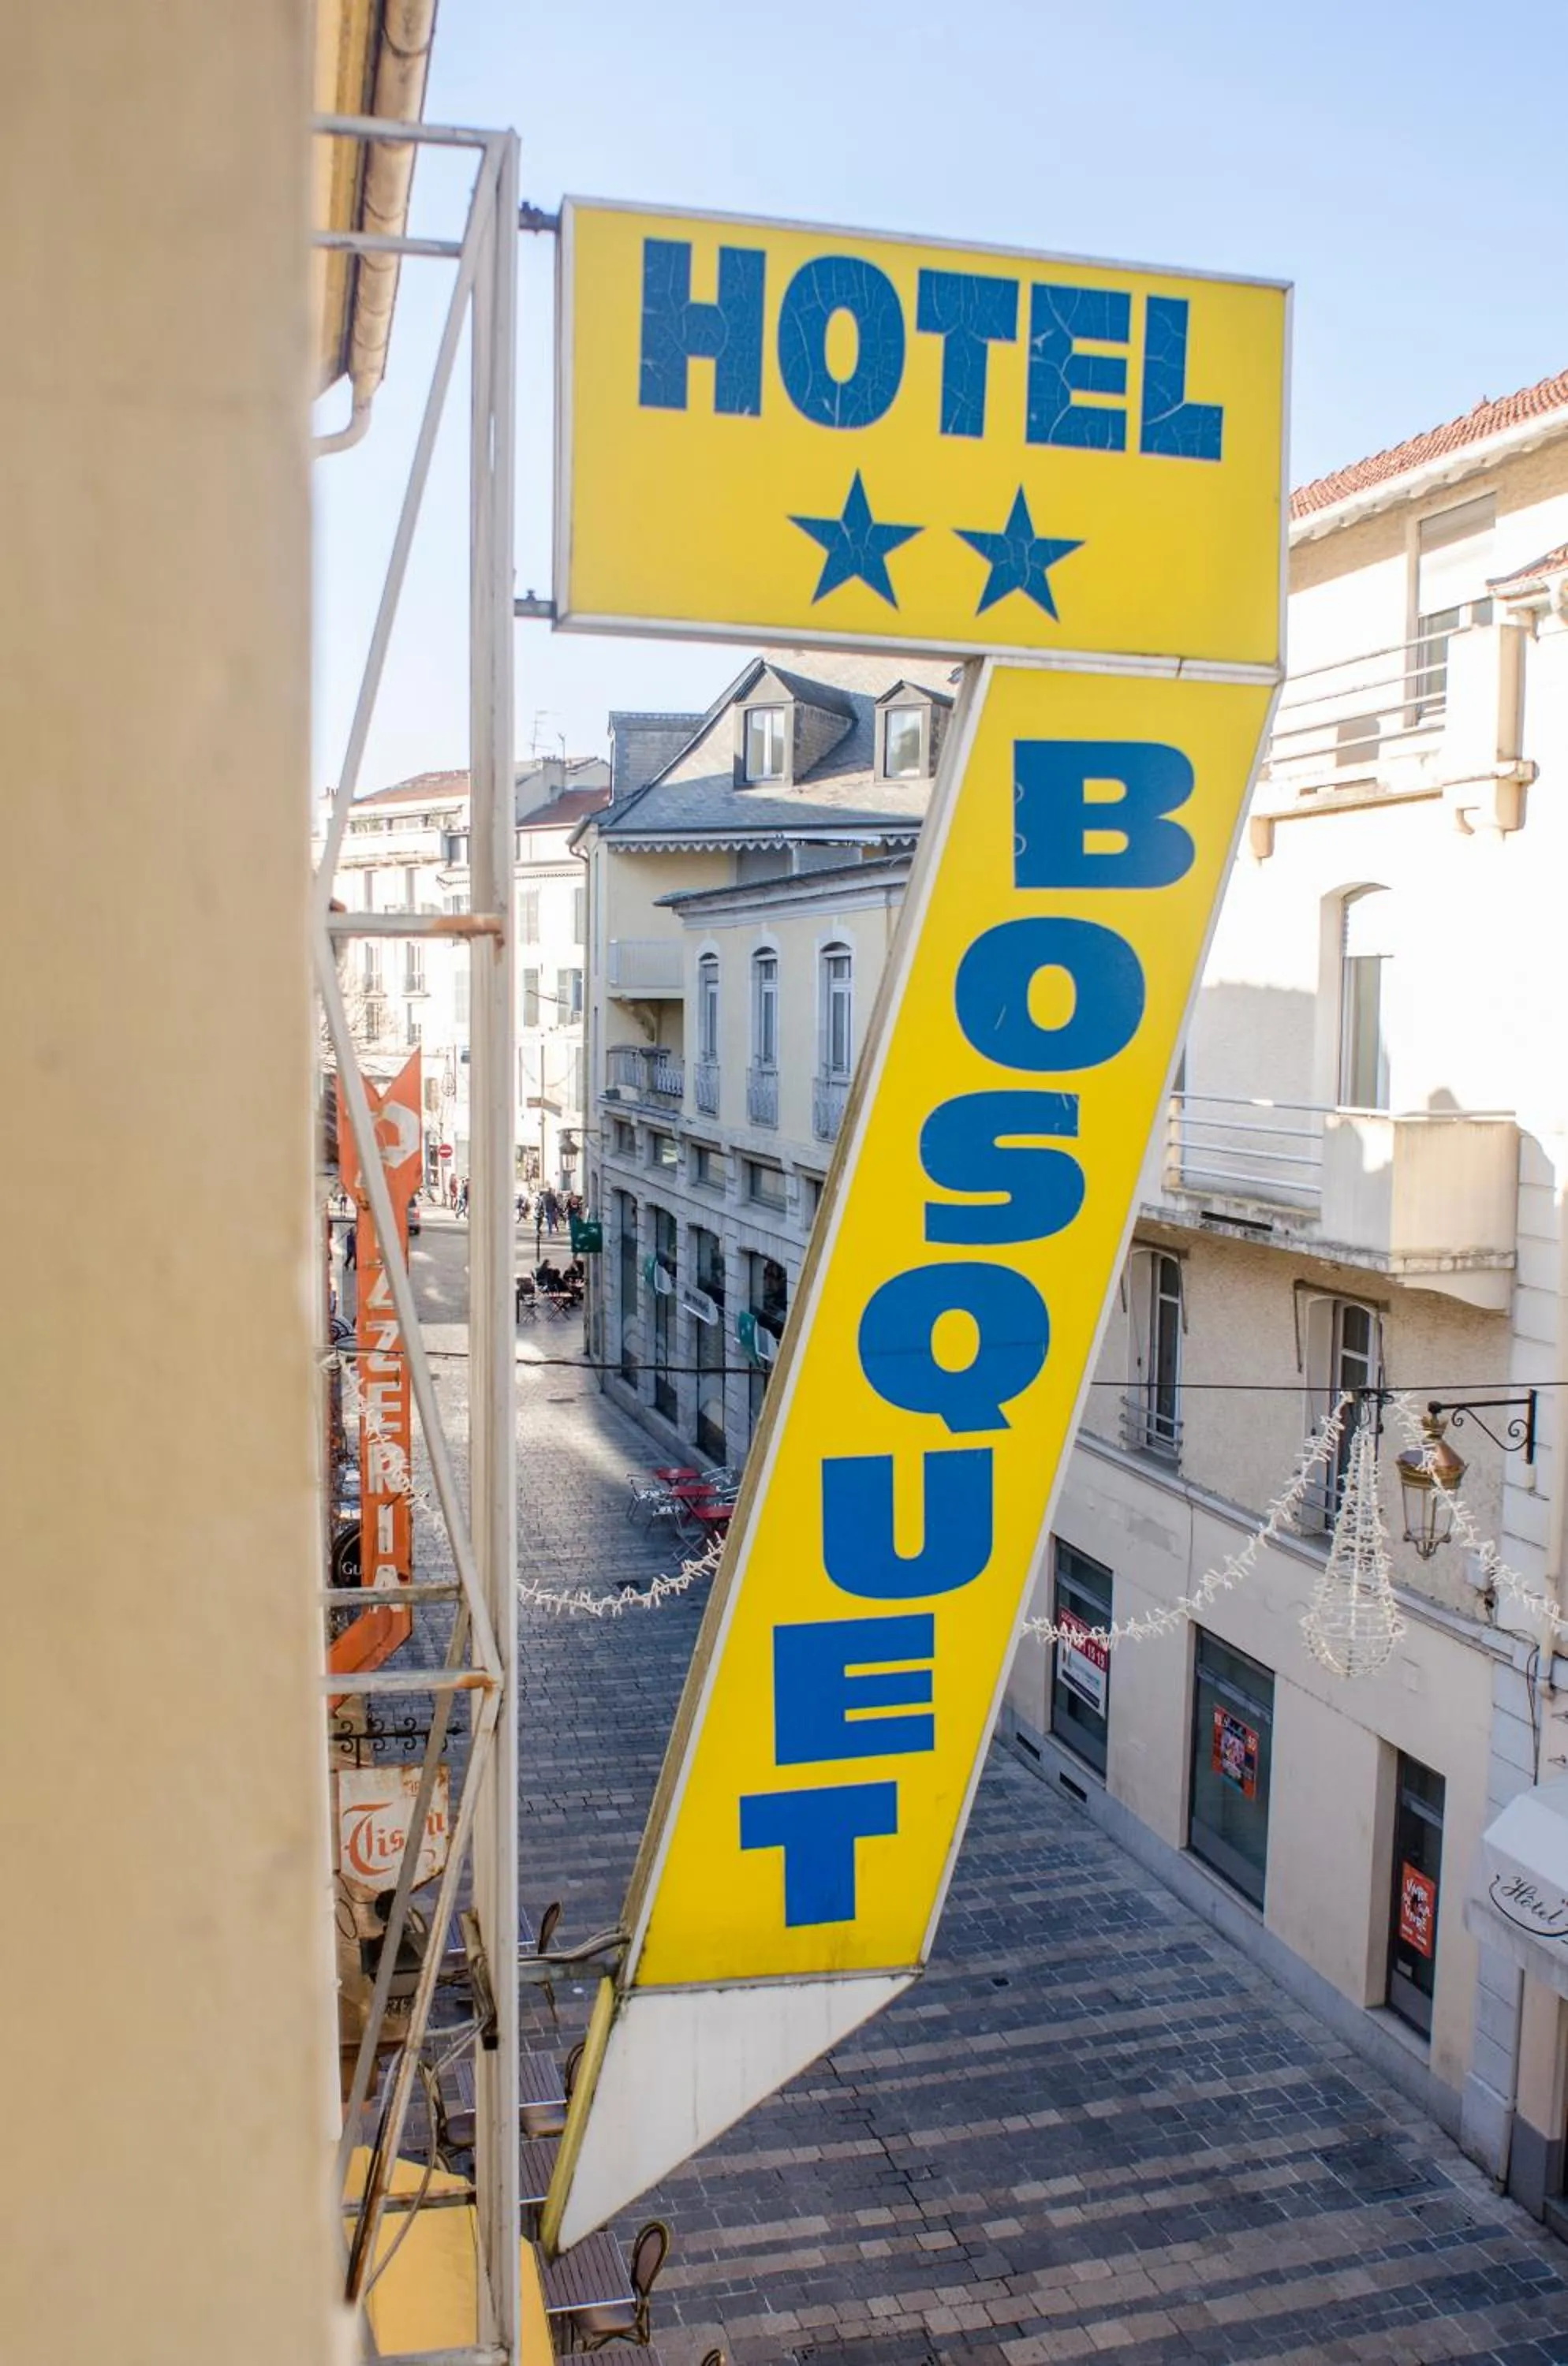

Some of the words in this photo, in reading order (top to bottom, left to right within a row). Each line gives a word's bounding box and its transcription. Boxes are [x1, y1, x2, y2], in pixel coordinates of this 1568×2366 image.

[640, 238, 1223, 462] HOTEL
[347, 1100, 420, 1614] PZZERIA
[740, 740, 1193, 1927] BOSQUET
[1500, 1875, 1563, 1925] Hôtel
